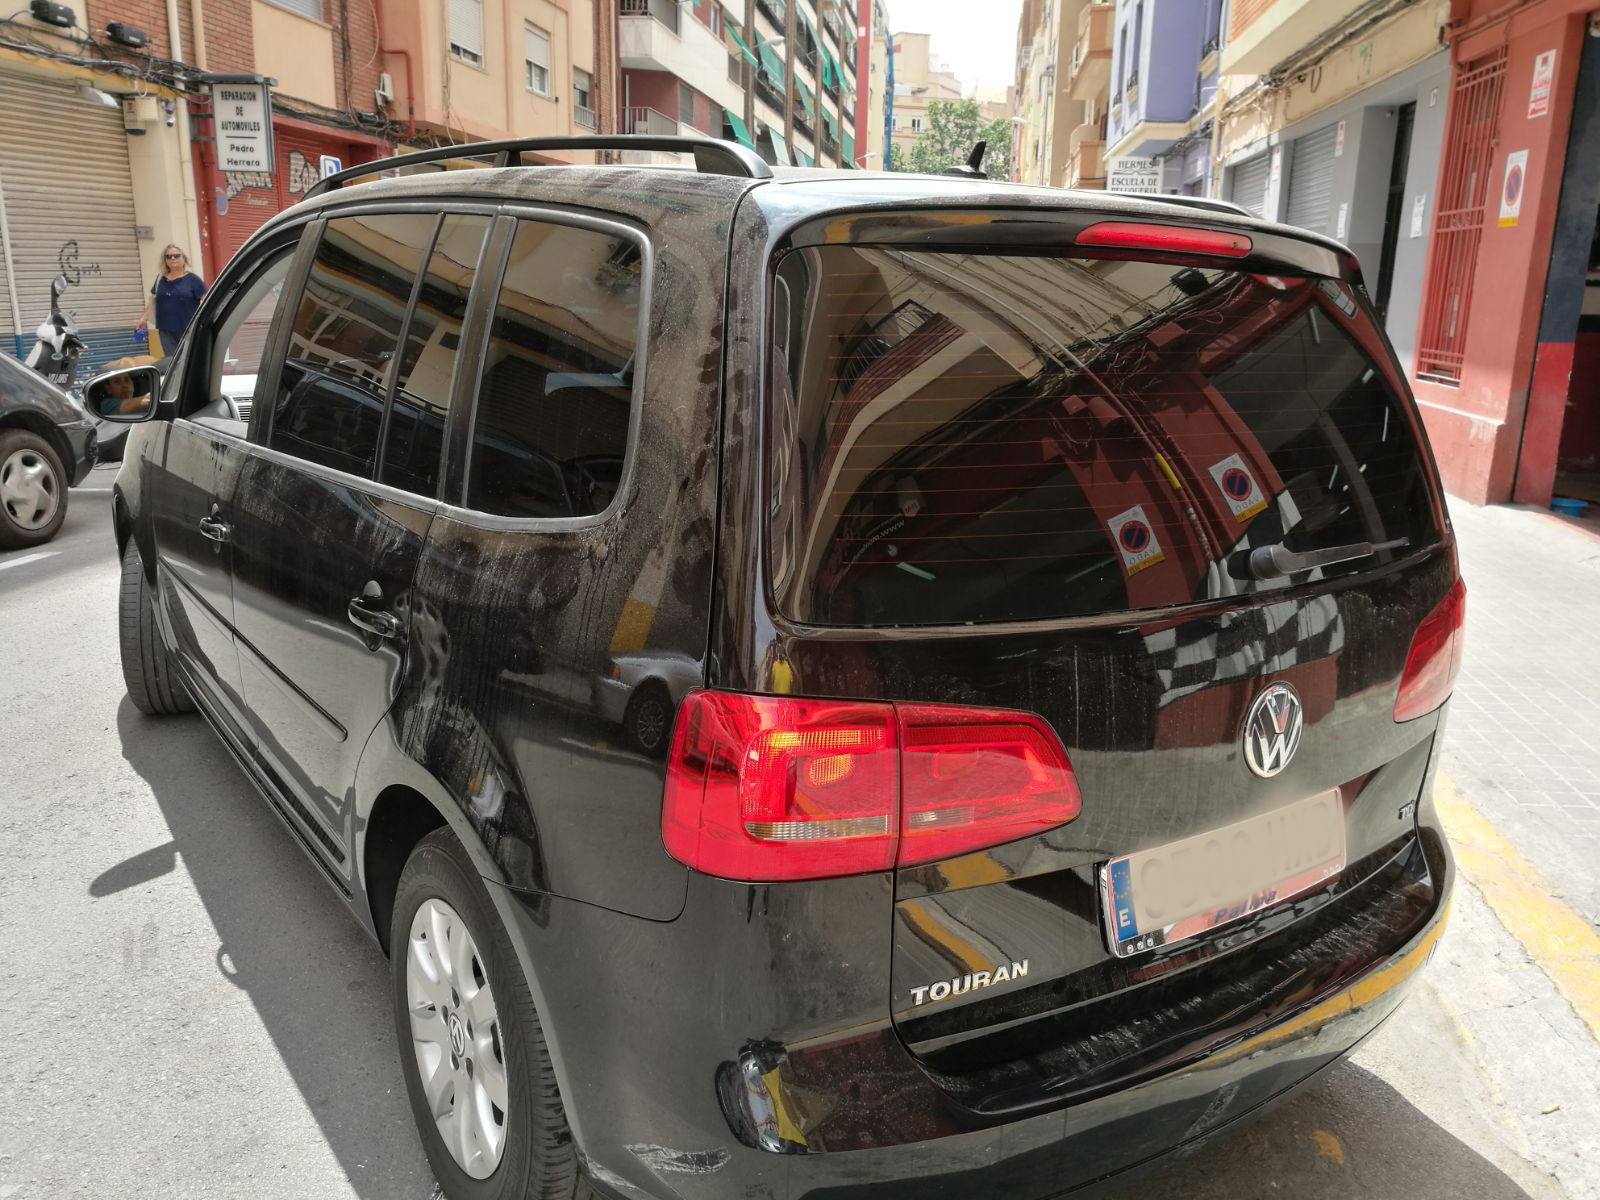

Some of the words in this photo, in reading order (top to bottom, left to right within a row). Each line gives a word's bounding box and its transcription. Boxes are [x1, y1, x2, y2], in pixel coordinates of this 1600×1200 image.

[220, 90, 257, 101] REPARACION
[235, 106, 244, 116] DE
[221, 121, 261, 132] AUTOMOVILES
[230, 144, 255, 153] Pedro
[226, 158, 260, 167] Herrera
[1118, 160, 1153, 169] HERMES
[1111, 177, 1145, 186] ESCUELA
[1147, 177, 1158, 186] DE
[1118, 908, 1132, 928] E
[909, 959, 1029, 1006] TOURAN
